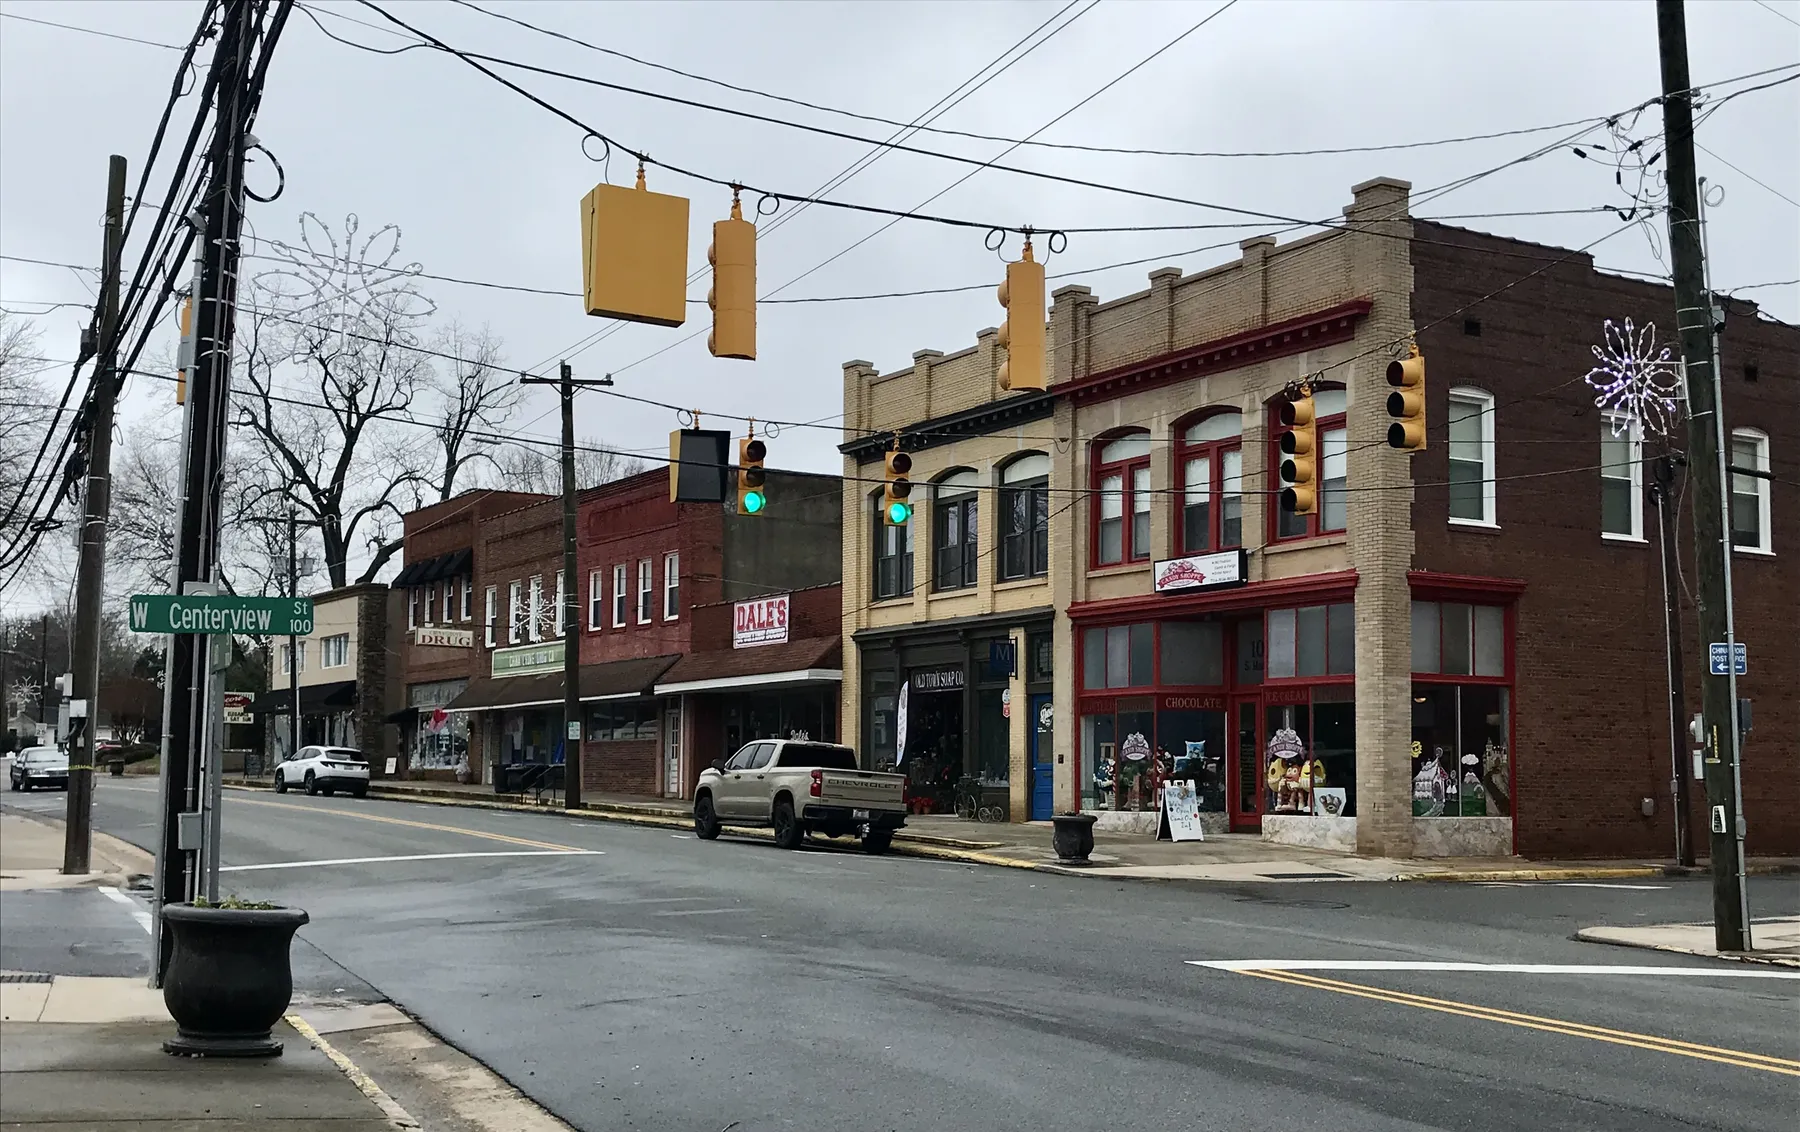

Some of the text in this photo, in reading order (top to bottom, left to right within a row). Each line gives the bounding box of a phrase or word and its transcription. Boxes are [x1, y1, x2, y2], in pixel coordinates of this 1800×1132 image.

[132, 601, 308, 631] W Centerview St
[736, 599, 787, 632] DALE'S
[289, 619, 311, 633] 100
[421, 635, 470, 646] DRUG
[996, 644, 1010, 661] M
[1165, 697, 1223, 708] CHOCOLATE
[827, 779, 899, 789] CHEVROLET
